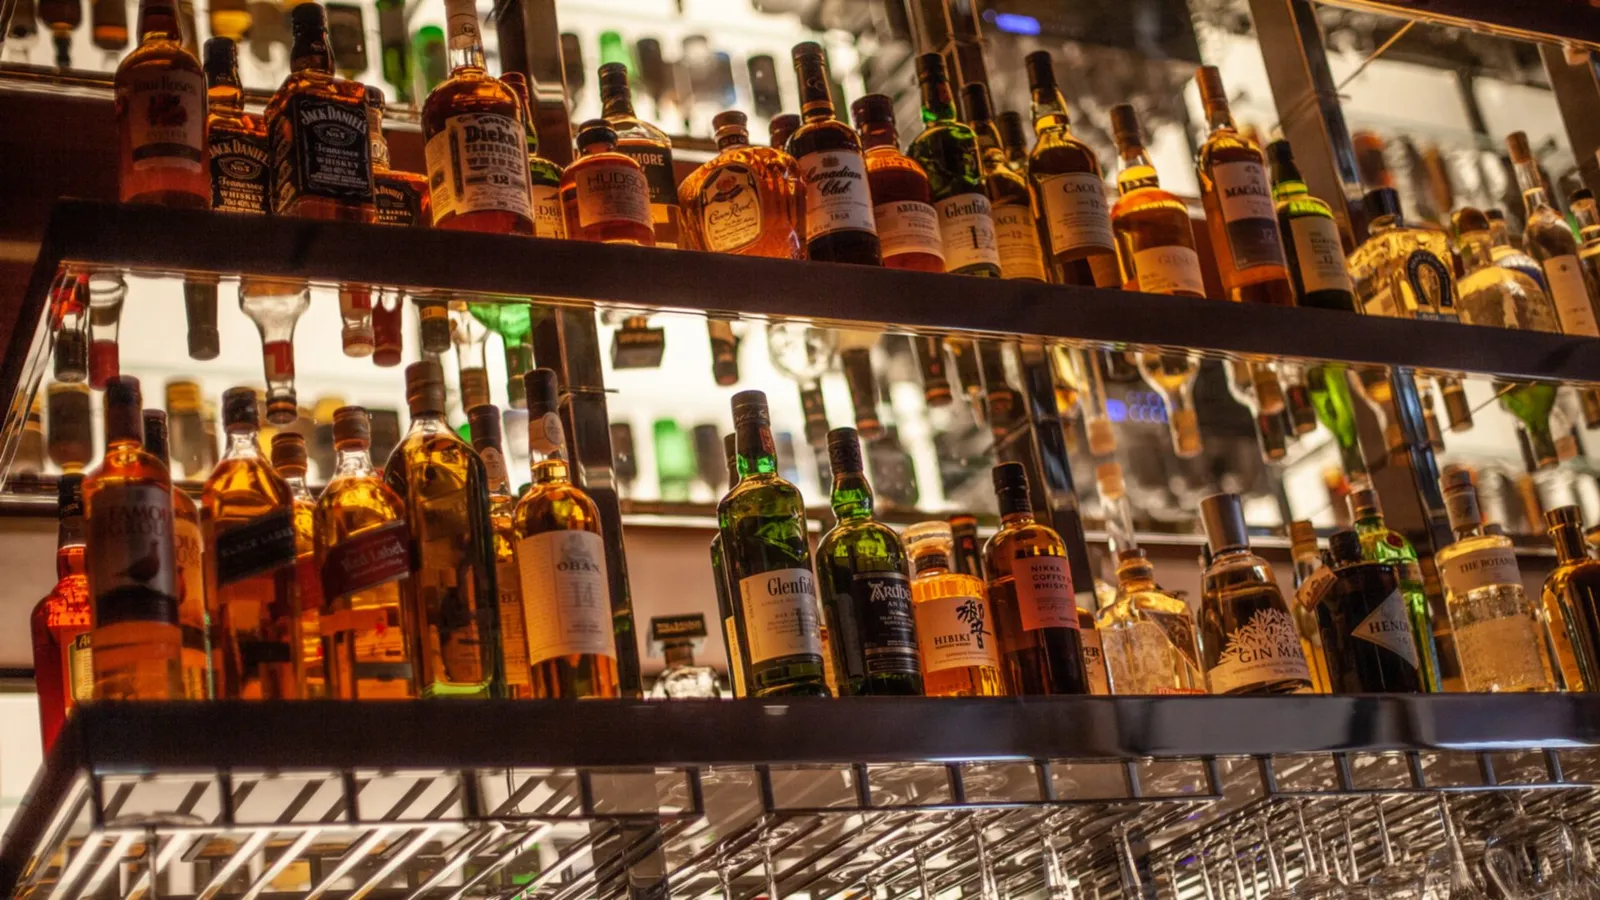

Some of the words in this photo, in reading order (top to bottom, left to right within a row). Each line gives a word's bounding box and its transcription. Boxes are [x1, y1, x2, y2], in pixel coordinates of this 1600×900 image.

[301, 109, 327, 125] JACK
[627, 152, 665, 166] MORE
[806, 165, 862, 183] Canadian
[817, 180, 852, 196] Club
[1031, 564, 1061, 572] NIKKA
[1460, 561, 1477, 573] THE
[934, 633, 970, 645] HIBIKI
[1239, 648, 1272, 663] GIN
